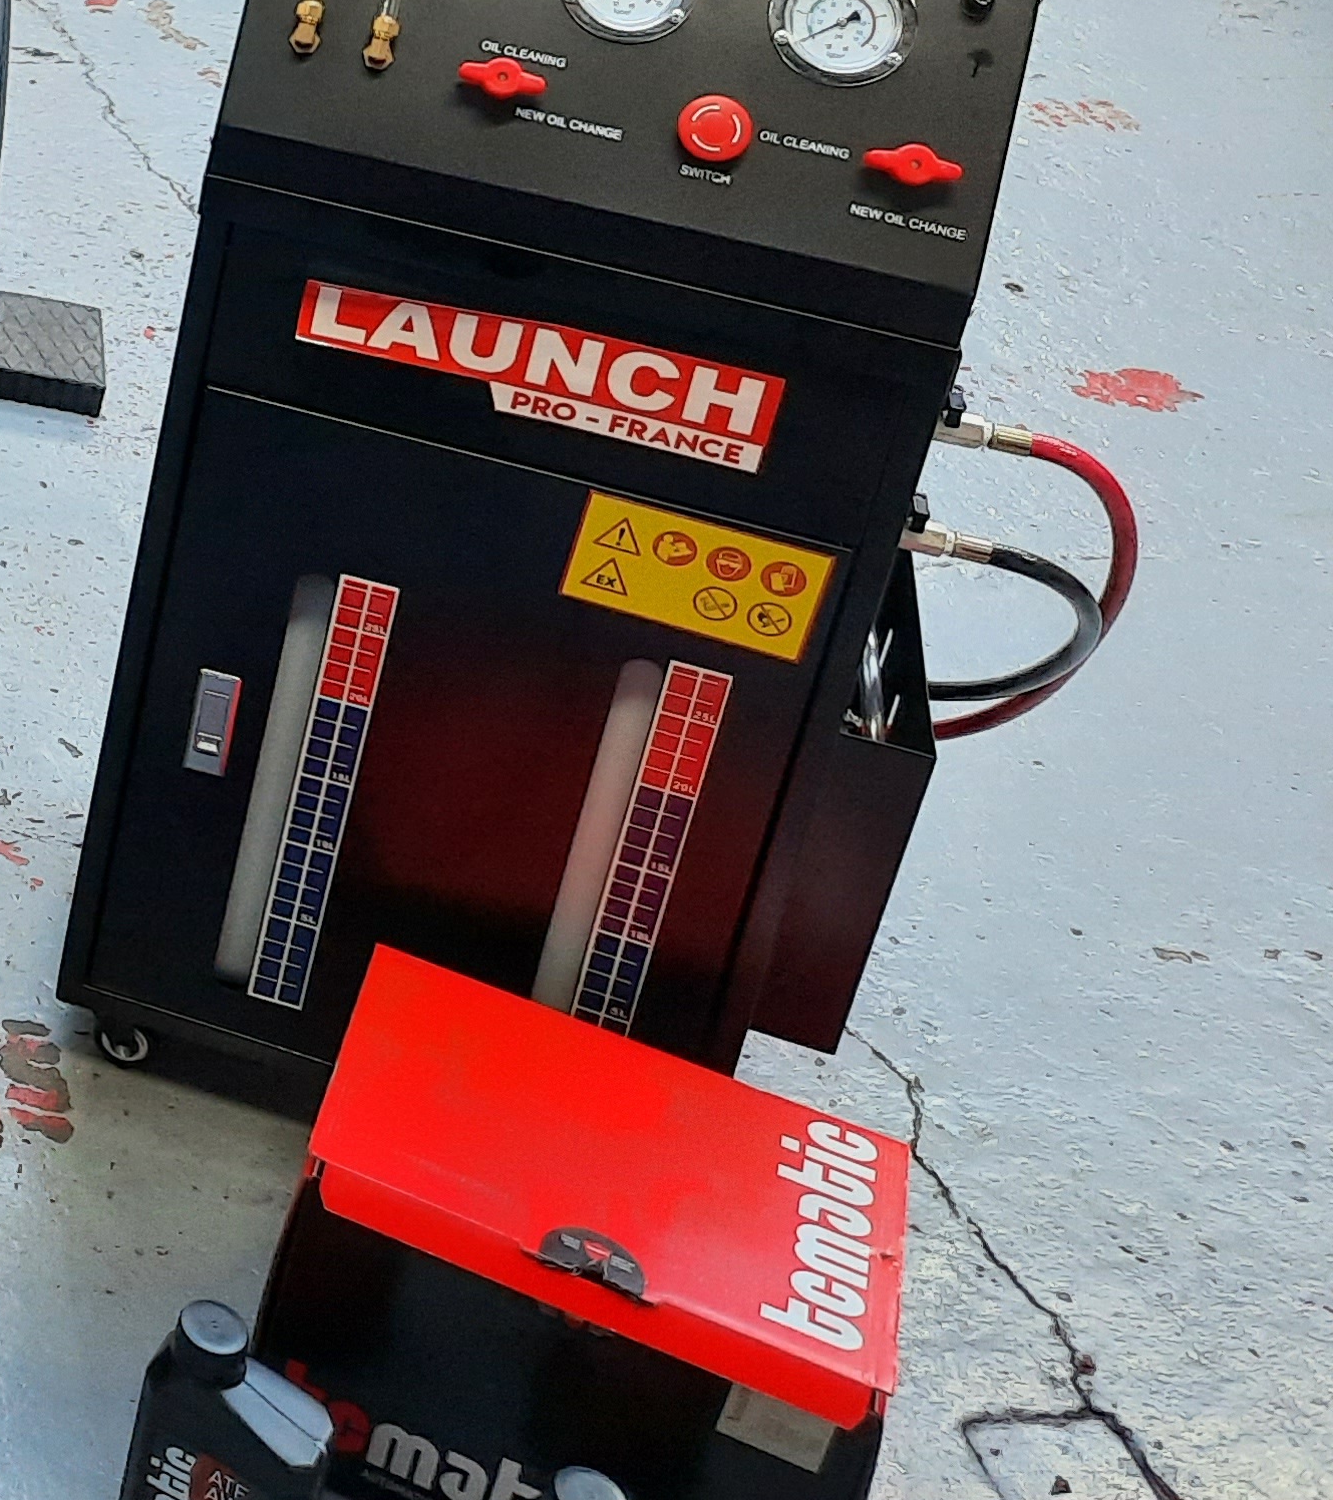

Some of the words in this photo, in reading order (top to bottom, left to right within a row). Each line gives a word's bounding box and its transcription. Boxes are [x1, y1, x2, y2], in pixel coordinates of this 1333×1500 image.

[482, 40, 501, 54] OIL
[503, 45, 566, 68] CLEANING
[514, 107, 545, 121] NEW
[546, 114, 567, 128] OIL
[569, 119, 623, 141] CHANGE
[760, 131, 780, 145] OIL
[783, 136, 850, 159] CLEANING
[679, 164, 731, 185] SWITCH
[850, 204, 883, 220] NEW
[885, 212, 906, 227] OIL
[909, 218, 967, 241] CHANGE
[309, 284, 766, 437] LAUNCH
[596, 573, 617, 588] EX
[692, 710, 716, 724] 25L
